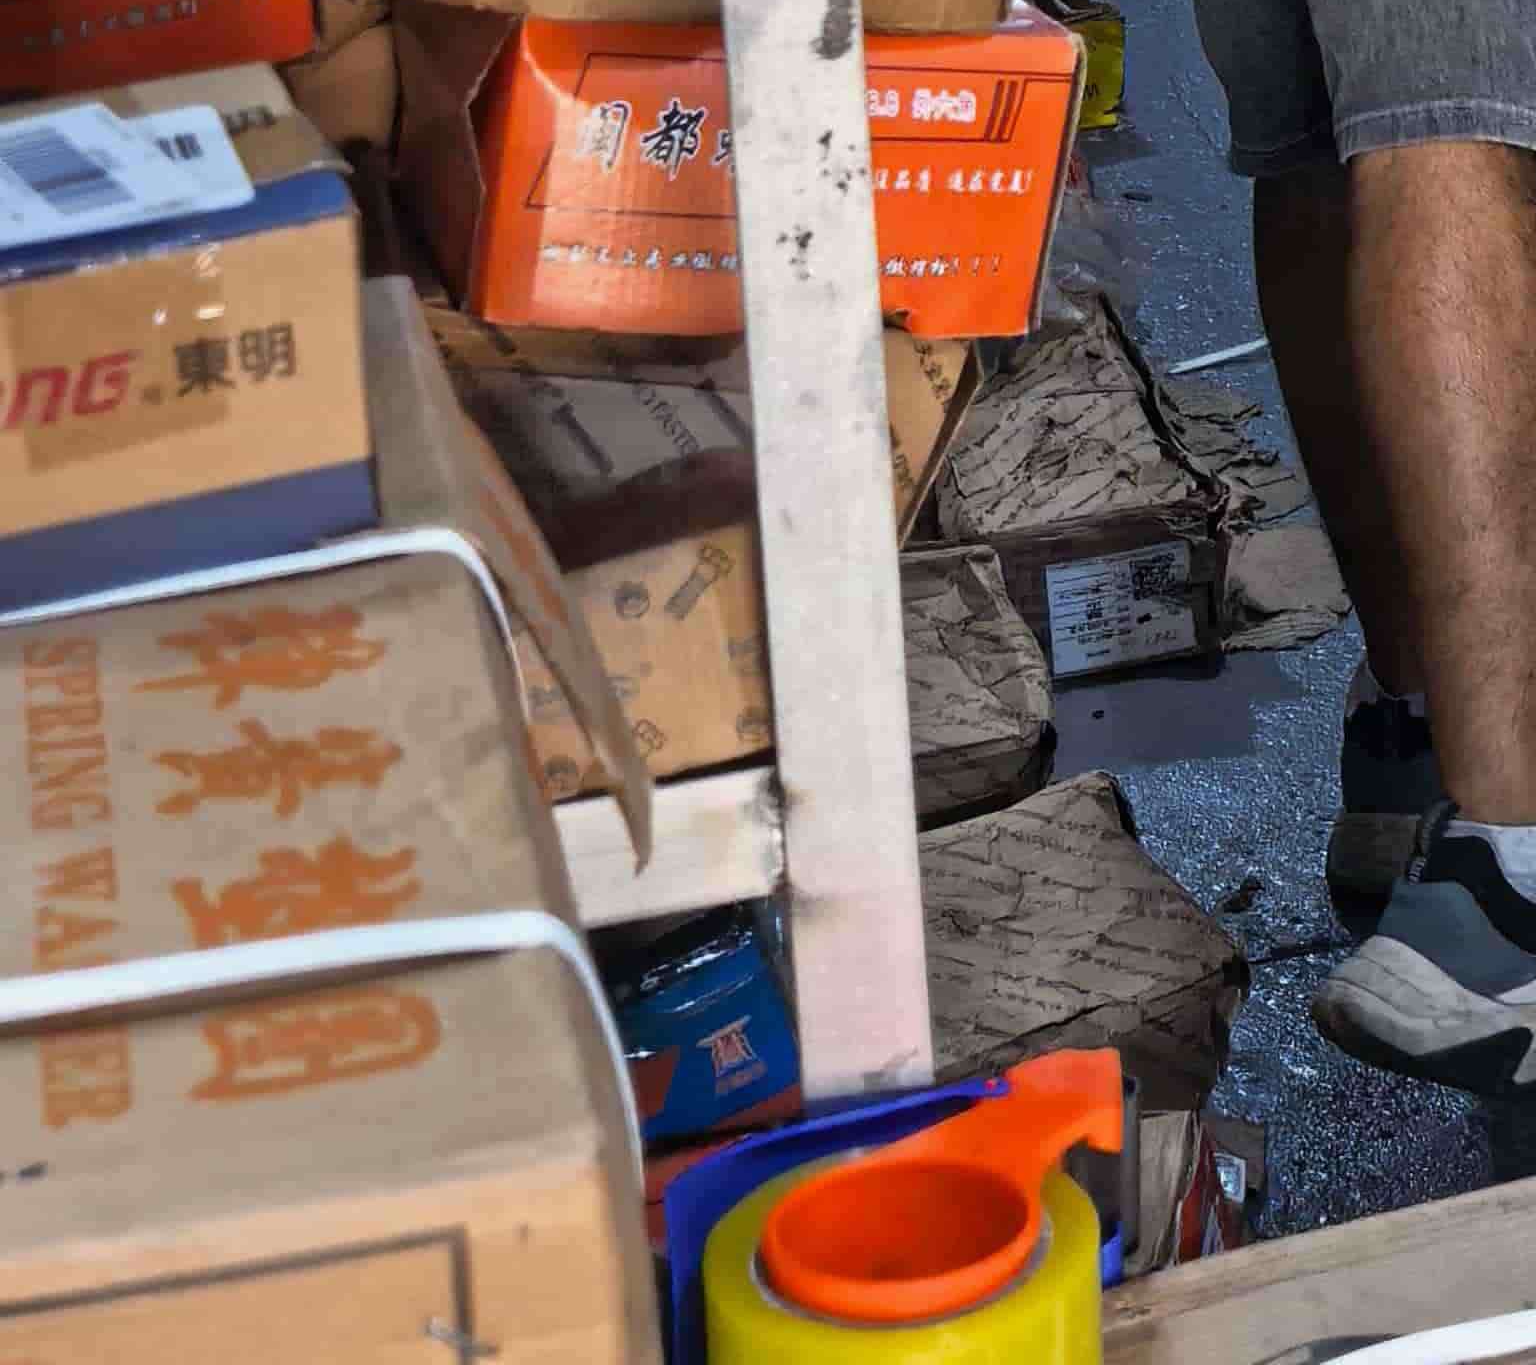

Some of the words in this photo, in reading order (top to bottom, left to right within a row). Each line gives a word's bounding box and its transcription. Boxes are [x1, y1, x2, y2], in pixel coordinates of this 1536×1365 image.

[173, 321, 297, 398] 東明
[23, 636, 114, 832] SPRING
[34, 846, 131, 1131] WAER
